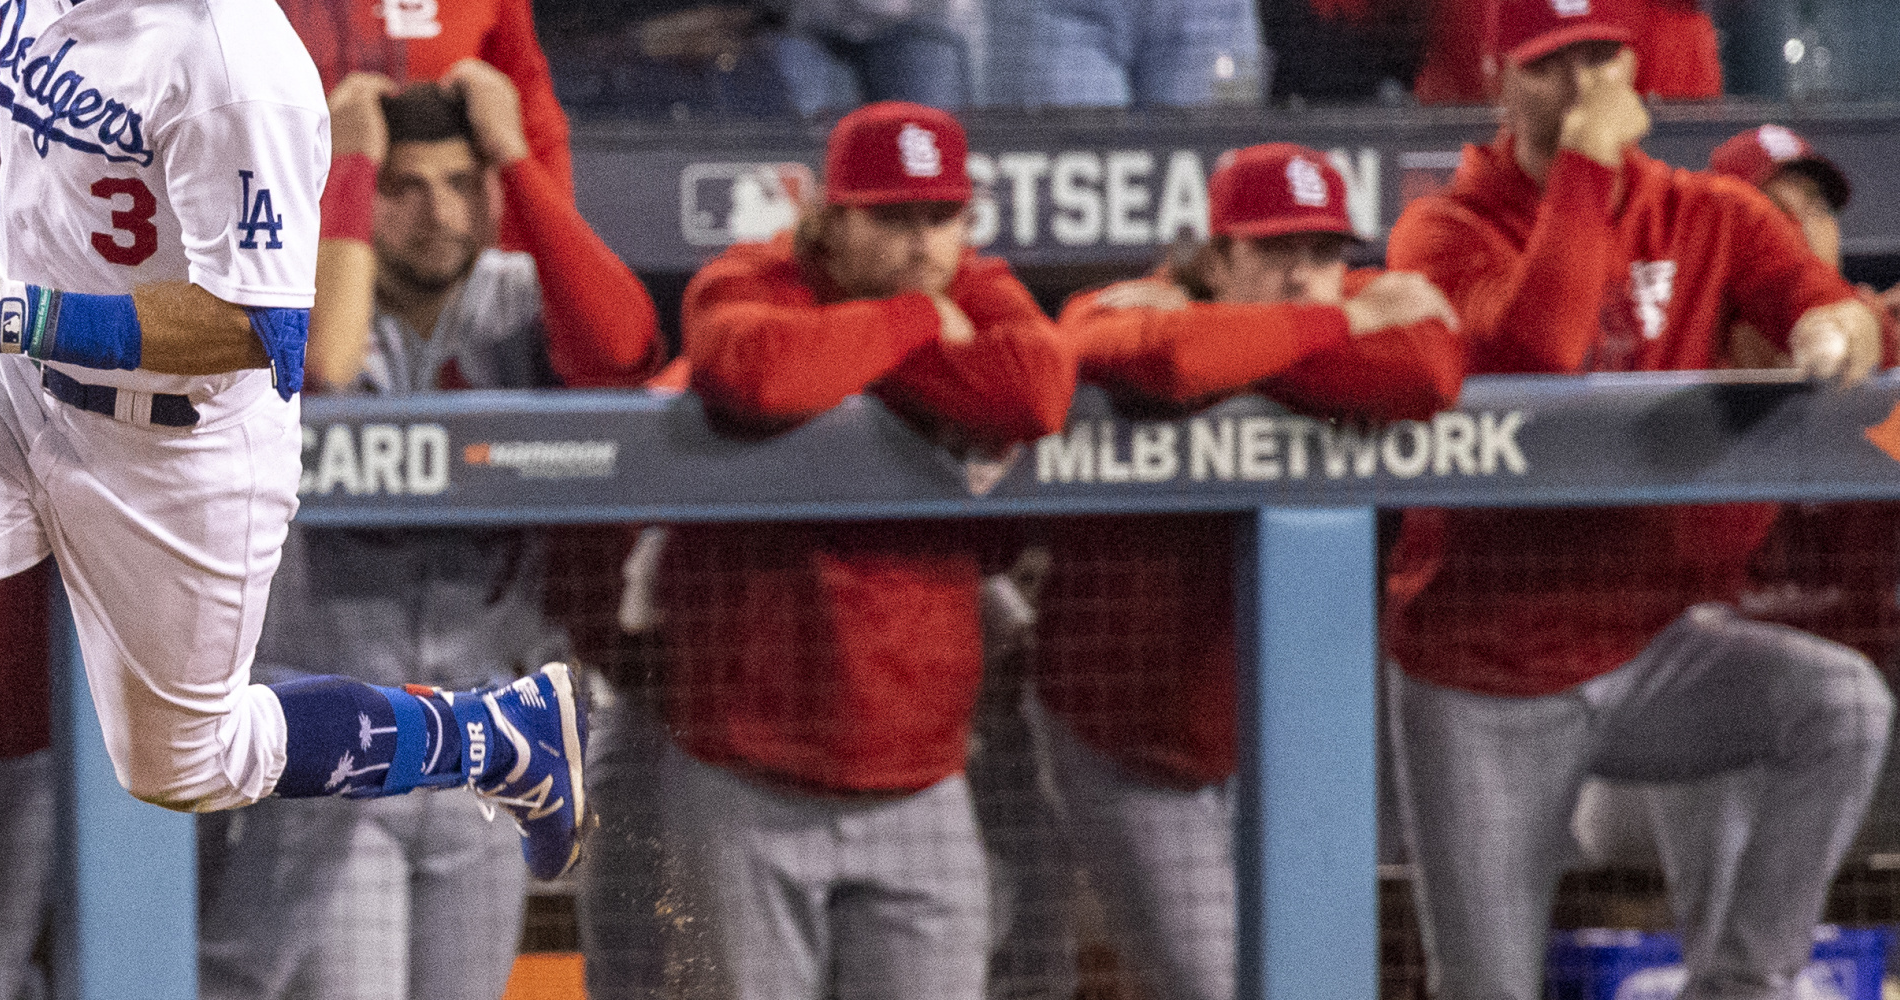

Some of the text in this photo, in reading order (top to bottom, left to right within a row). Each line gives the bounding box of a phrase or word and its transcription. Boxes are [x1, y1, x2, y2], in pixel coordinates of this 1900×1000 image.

[91, 177, 159, 267] 3
[238, 169, 283, 249] LA
[1036, 410, 1527, 483] MLB NETWORK
